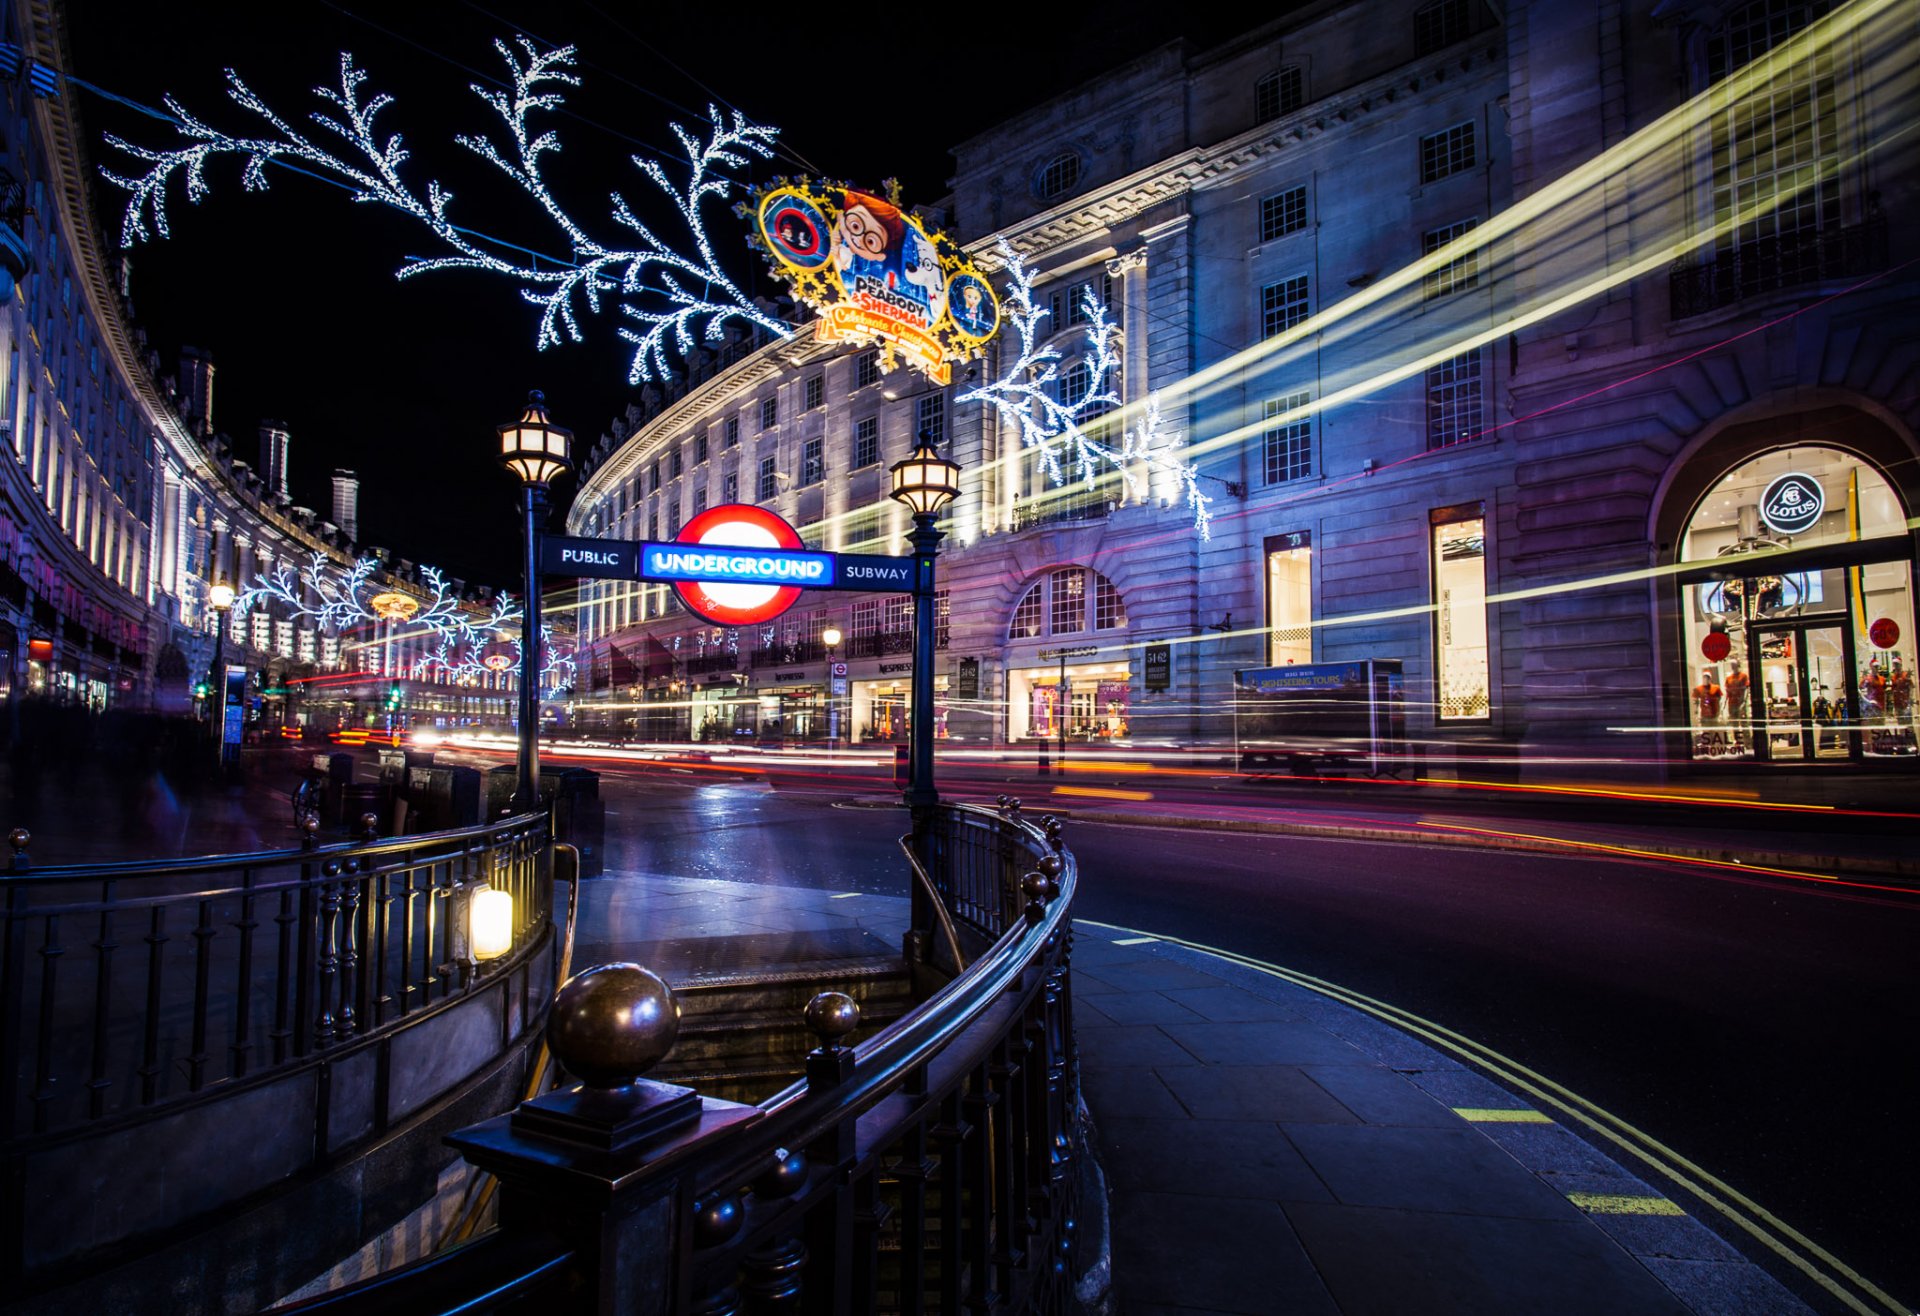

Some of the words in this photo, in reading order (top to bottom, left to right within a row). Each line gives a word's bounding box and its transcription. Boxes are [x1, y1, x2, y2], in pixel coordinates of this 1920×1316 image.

[855, 276, 925, 317] PEABODY
[834, 308, 889, 331] Celebrate
[860, 292, 927, 330] SHERMAN
[1770, 499, 1816, 517] LOTUS
[561, 548, 620, 566] PUBLIC
[653, 551, 824, 579] UNDERGROUND
[846, 565, 909, 581] SUBWAY
[1261, 676, 1312, 688] SIGHTSEEING
[1312, 674, 1341, 685] TOURS
[1701, 731, 1744, 745] SALE
